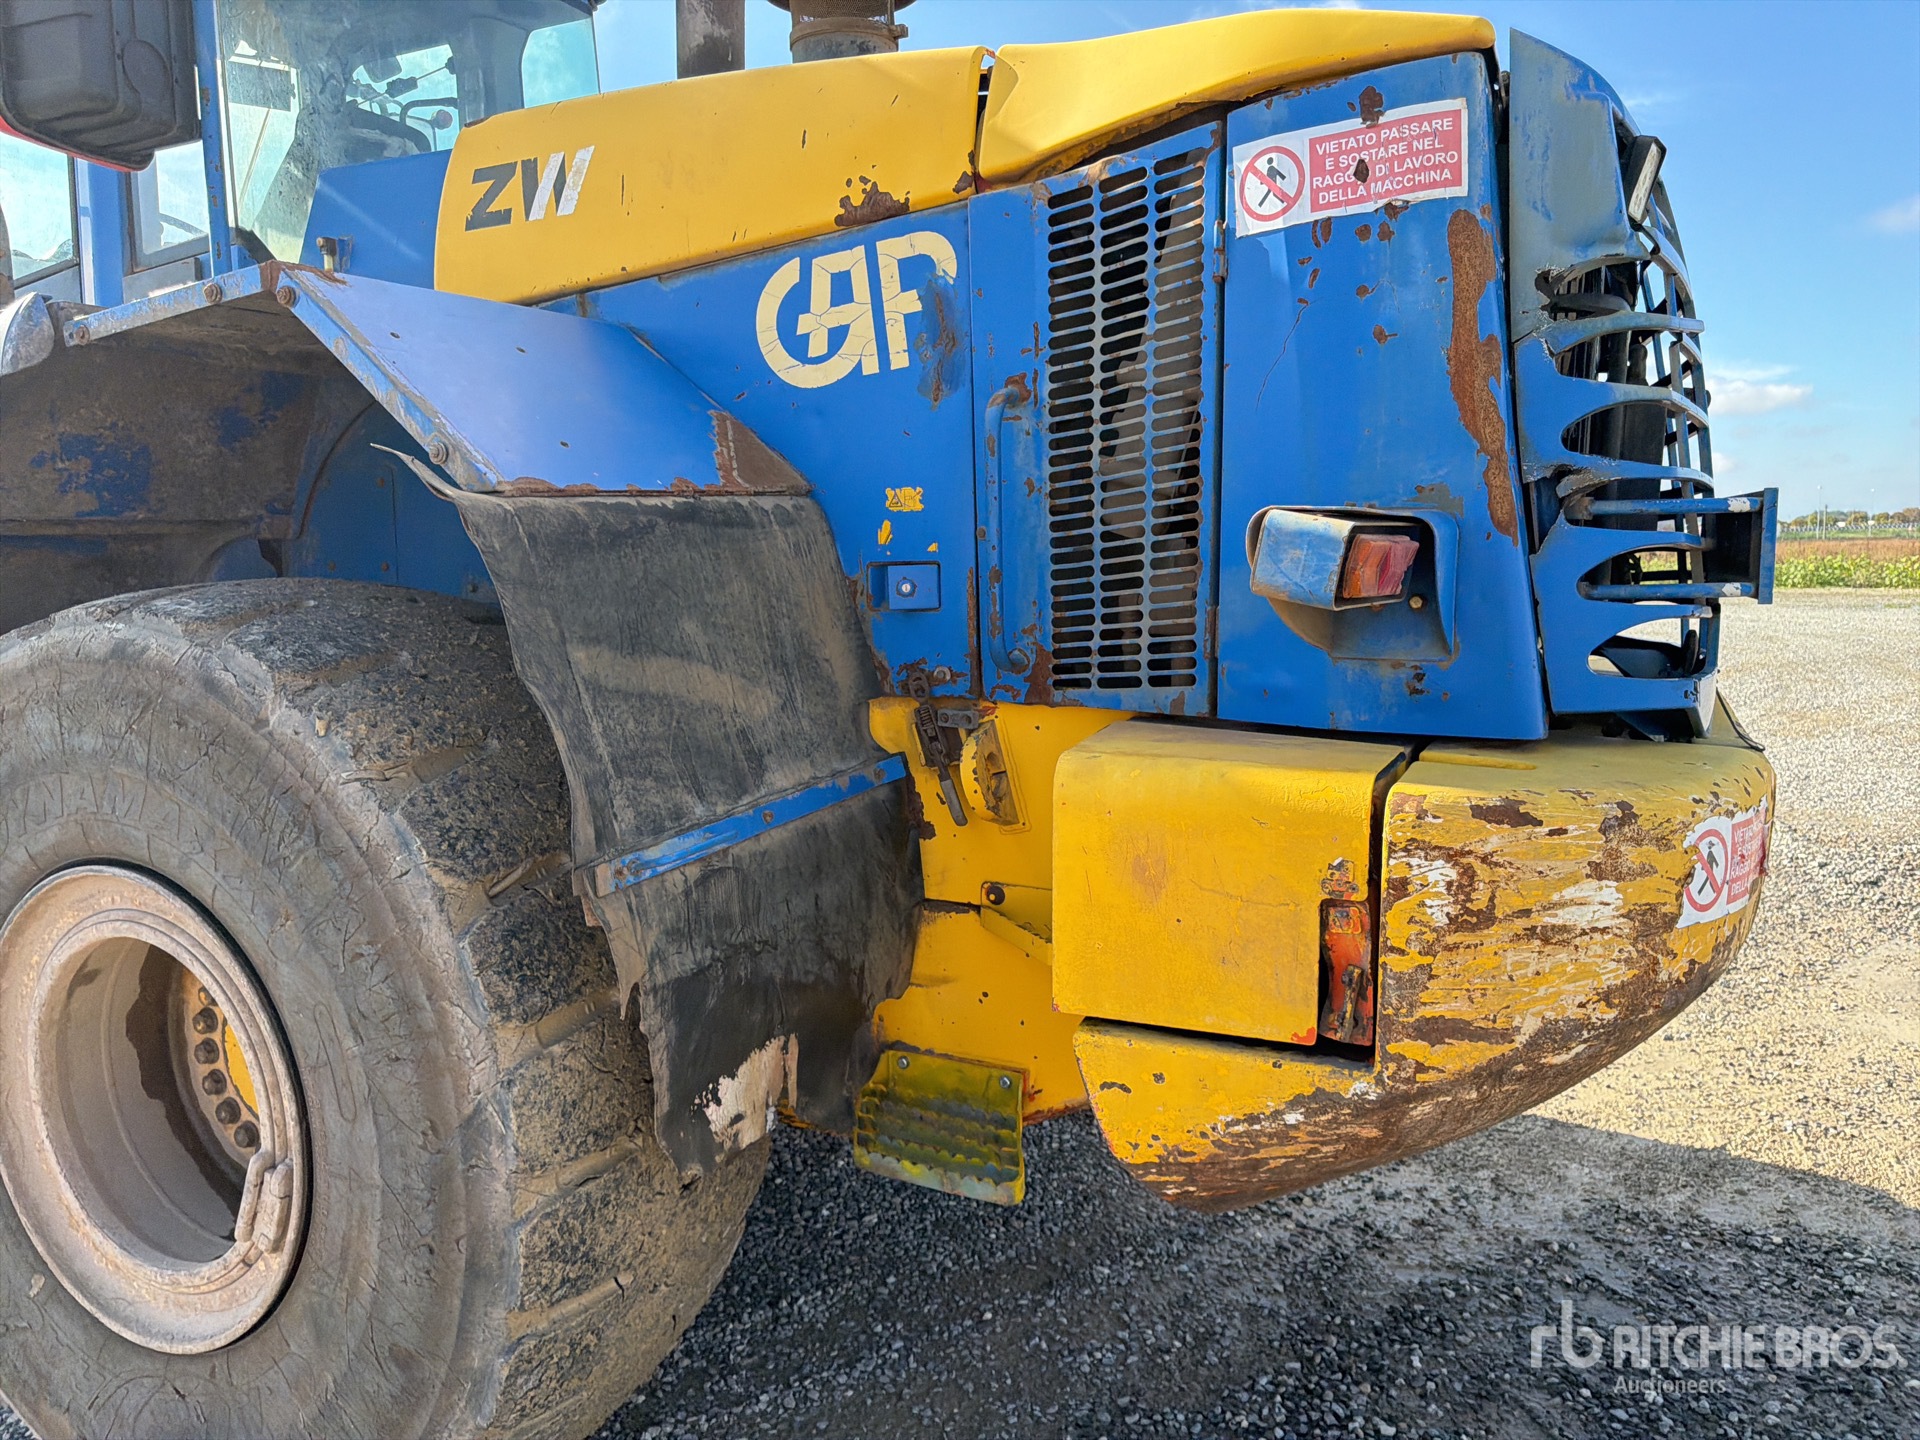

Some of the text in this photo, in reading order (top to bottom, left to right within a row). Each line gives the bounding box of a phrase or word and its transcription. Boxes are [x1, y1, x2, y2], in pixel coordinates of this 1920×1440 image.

[1316, 118, 1453, 155] VIETATO PASSARE
[1325, 137, 1444, 170] E SOSTARE NEL
[465, 145, 595, 232] ZW
[1313, 151, 1459, 189] RAGG DI LAVORO
[1319, 168, 1453, 204] DELLA MACCHINA
